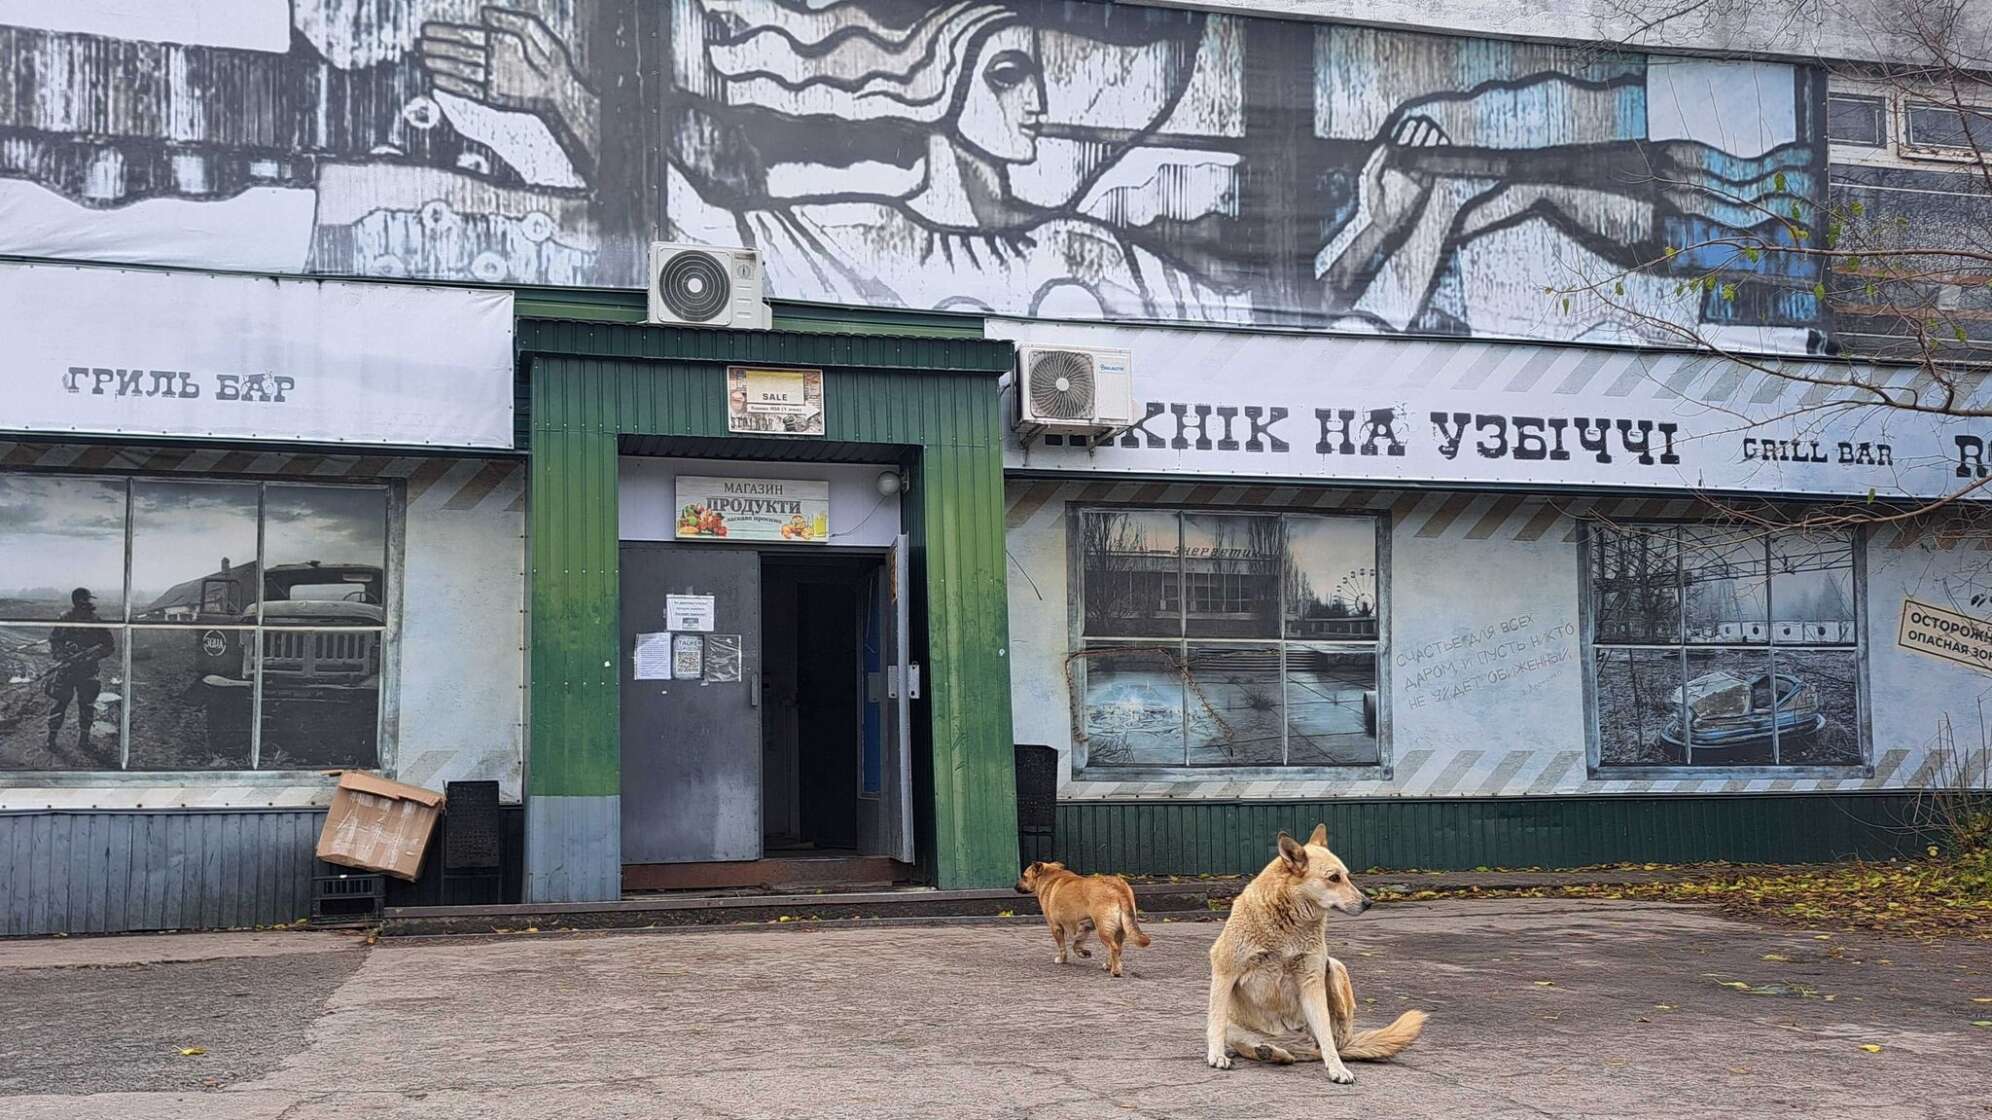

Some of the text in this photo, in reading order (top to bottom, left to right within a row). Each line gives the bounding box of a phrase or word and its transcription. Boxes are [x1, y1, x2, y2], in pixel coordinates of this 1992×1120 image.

[67, 367, 295, 402] ГРИЛЬ БАР
[762, 393, 788, 401] SALE
[1315, 407, 1406, 457] НА
[1430, 411, 1680, 466] УЗБІЧЧІ
[1743, 438, 1893, 466] GRILL BAR
[1955, 435, 1992, 478] R
[724, 482, 783, 495] МАГАЗИН
[706, 497, 801, 515] ПРОДУКТИ
[1396, 614, 1535, 667] СЧАСТЬЕ ДЛЯ ВСЕХ
[1908, 630, 1969, 654] ОПАСНАЯ
[1404, 663, 1457, 692] ДАРОМ
[1478, 641, 1526, 665] ПУСТЬ
[1408, 695, 1425, 710] НЕ
